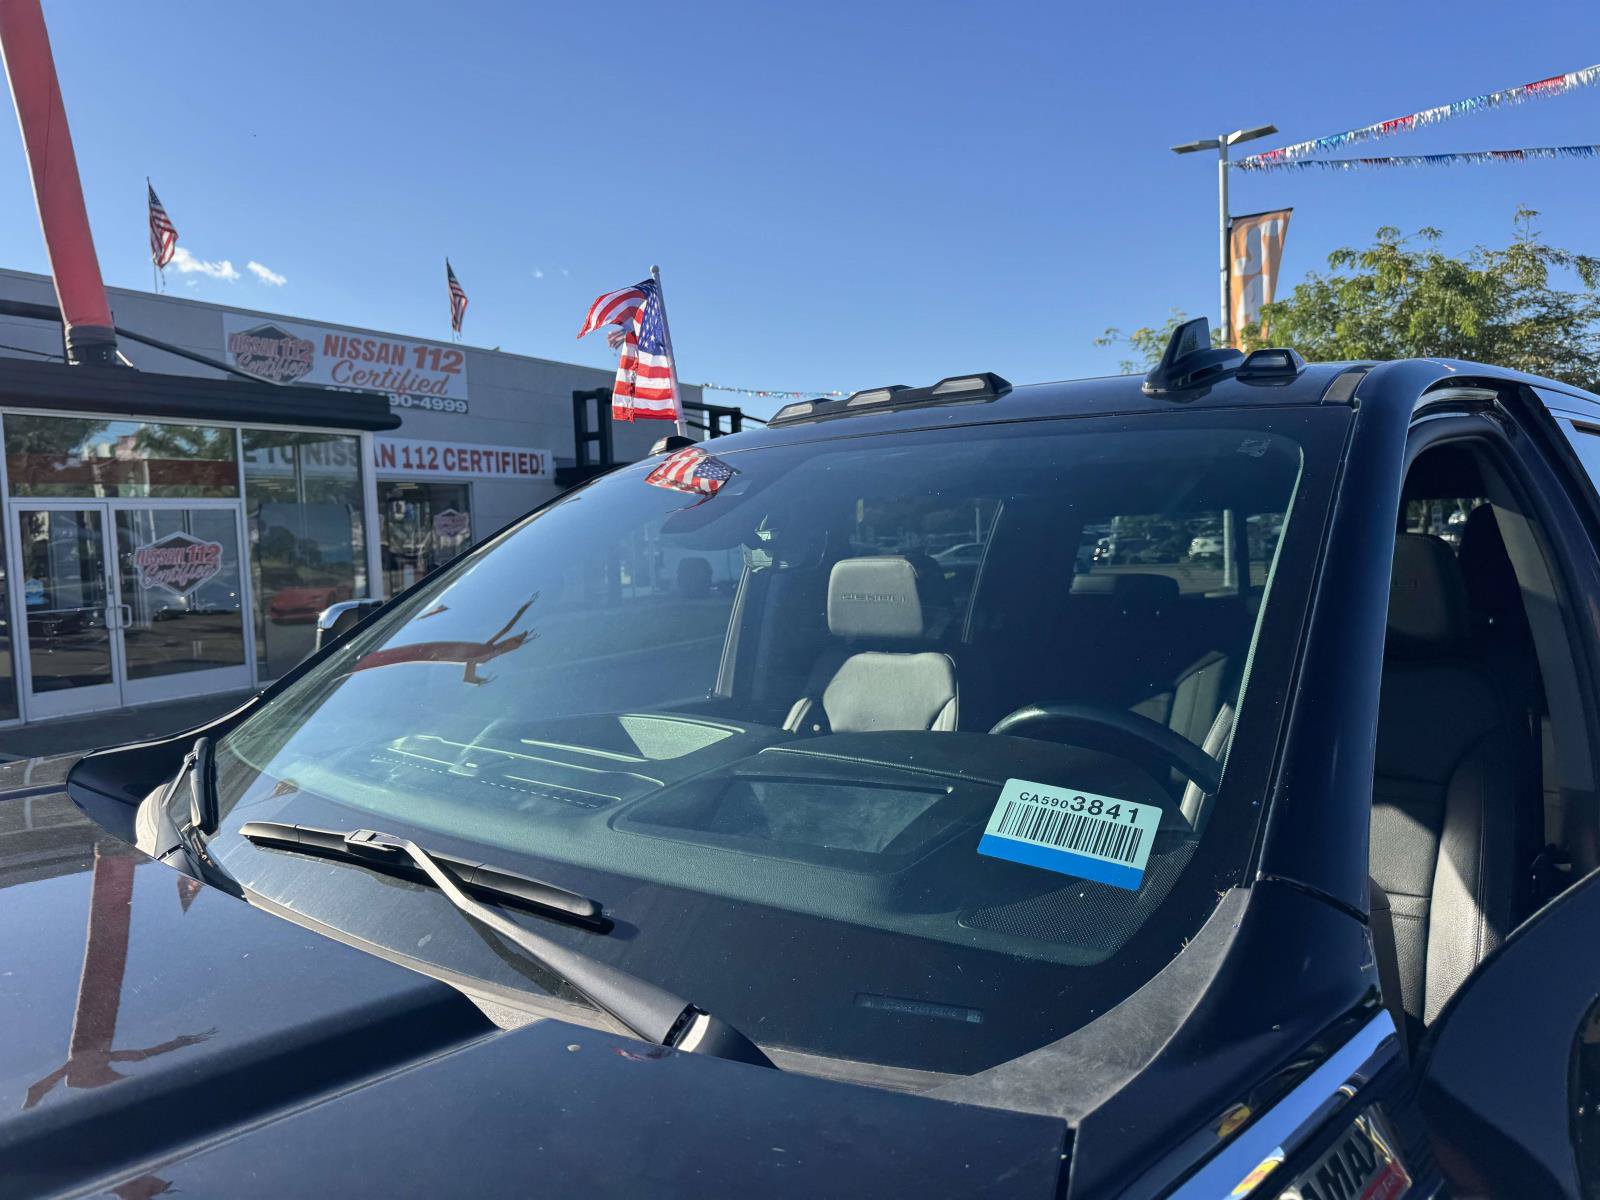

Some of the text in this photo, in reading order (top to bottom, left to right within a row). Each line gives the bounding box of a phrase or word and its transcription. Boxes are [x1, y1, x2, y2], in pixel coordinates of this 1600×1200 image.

[323, 334, 464, 375] NISSAN 112
[331, 359, 449, 396] Certified
[402, 446, 439, 470] 112
[443, 447, 546, 475] CERTIFIED!
